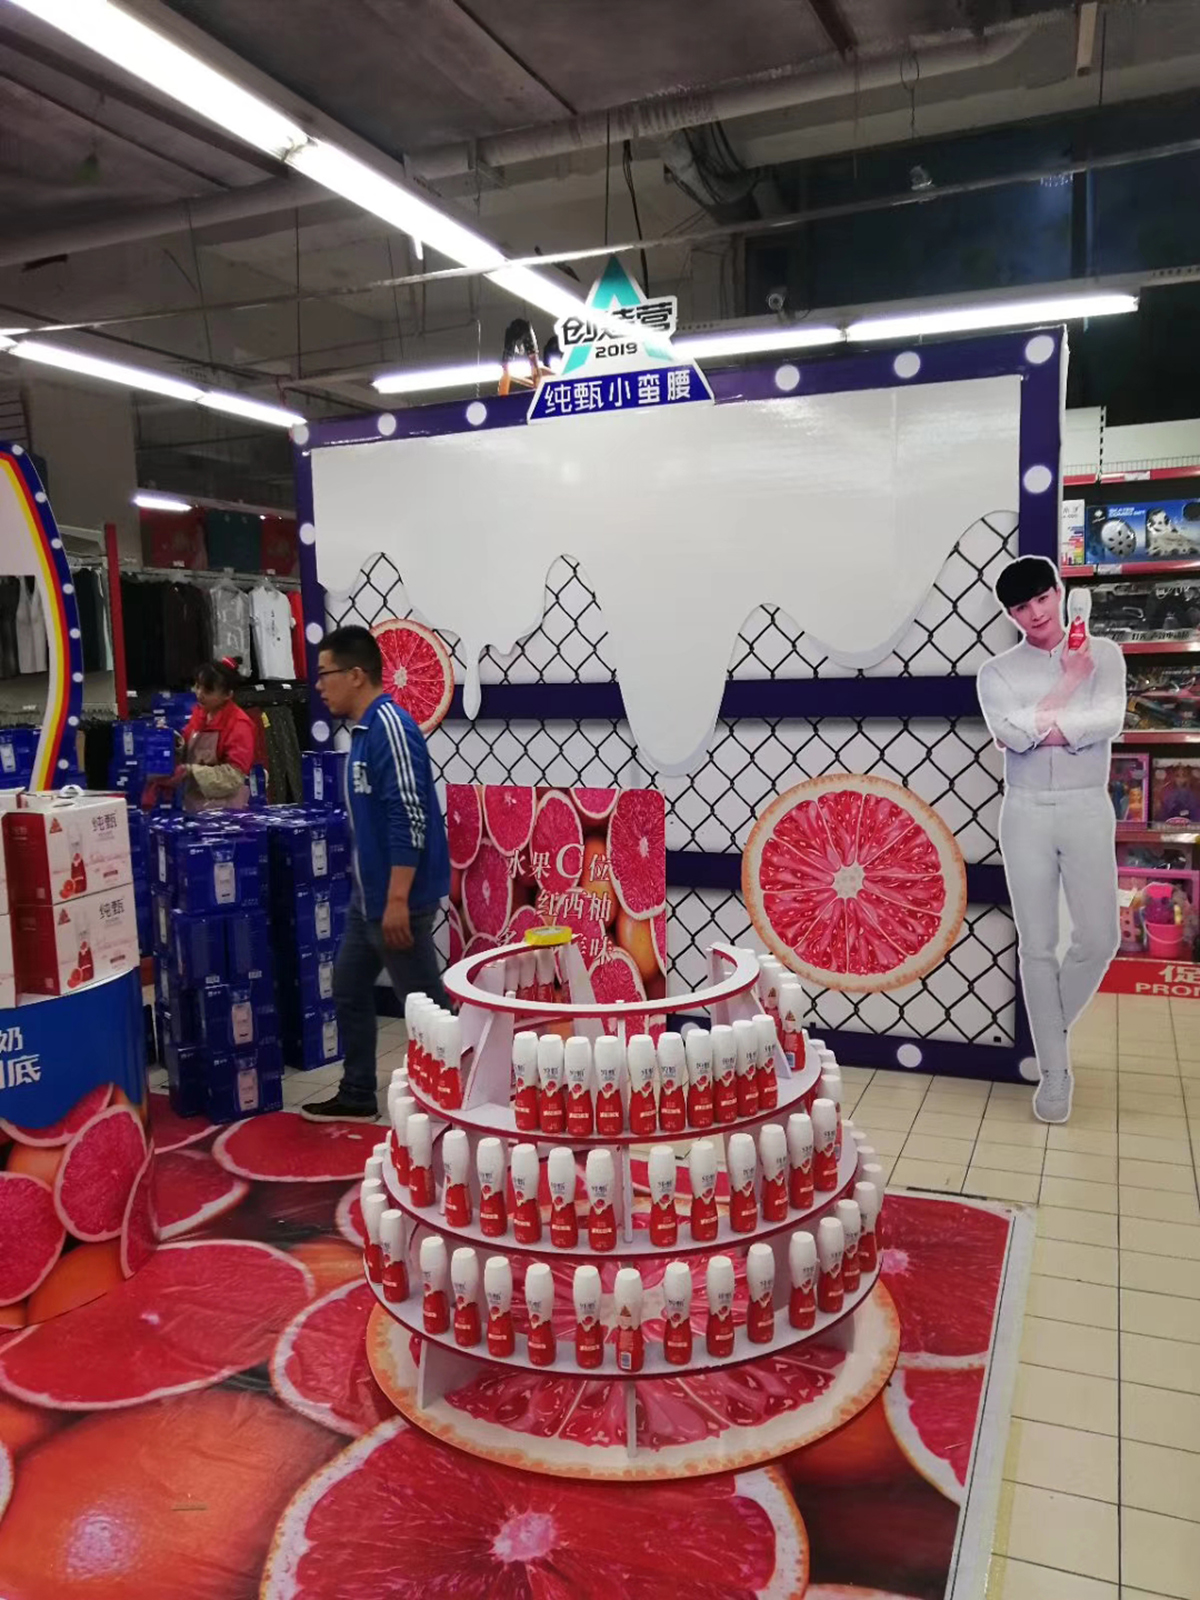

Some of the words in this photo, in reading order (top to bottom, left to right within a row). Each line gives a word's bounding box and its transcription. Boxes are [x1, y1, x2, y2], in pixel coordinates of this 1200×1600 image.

[595, 342, 638, 359] 2019
[545, 370, 691, 414] 纯甄小蛮腰
[506, 843, 612, 882] 水果C位
[536, 888, 612, 922] 红西柚
[0, 1054, 42, 1090] 底
